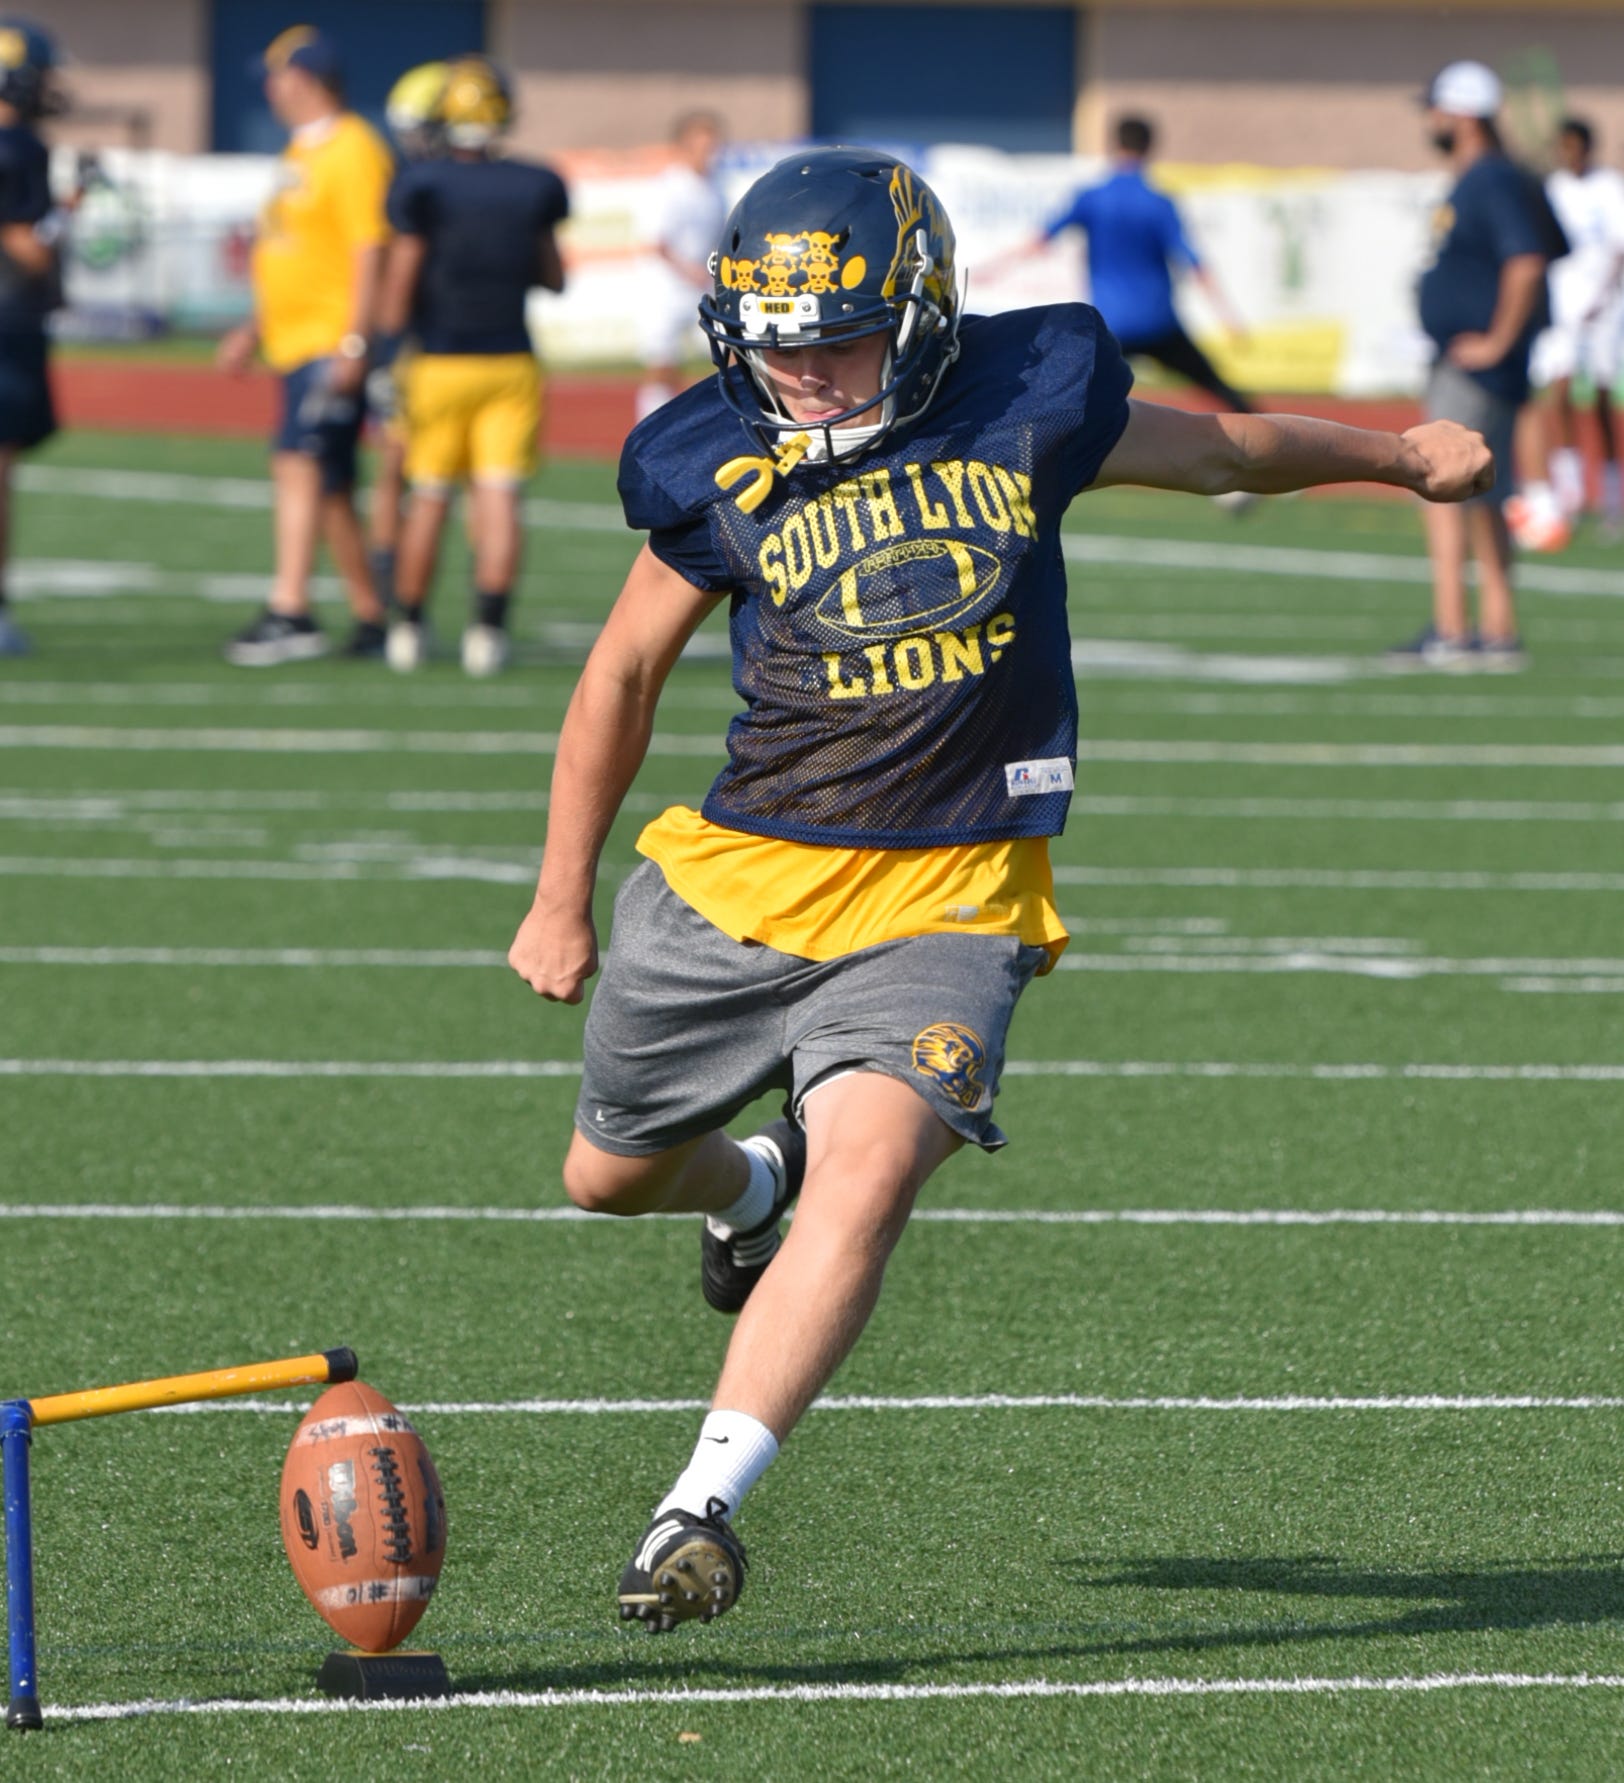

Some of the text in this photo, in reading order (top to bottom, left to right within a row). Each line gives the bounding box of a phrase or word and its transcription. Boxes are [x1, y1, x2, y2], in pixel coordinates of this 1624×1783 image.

[758, 460, 1039, 607] SOUTH LYON
[821, 613, 1016, 700] LIONS
[1050, 773, 1062, 784] M
